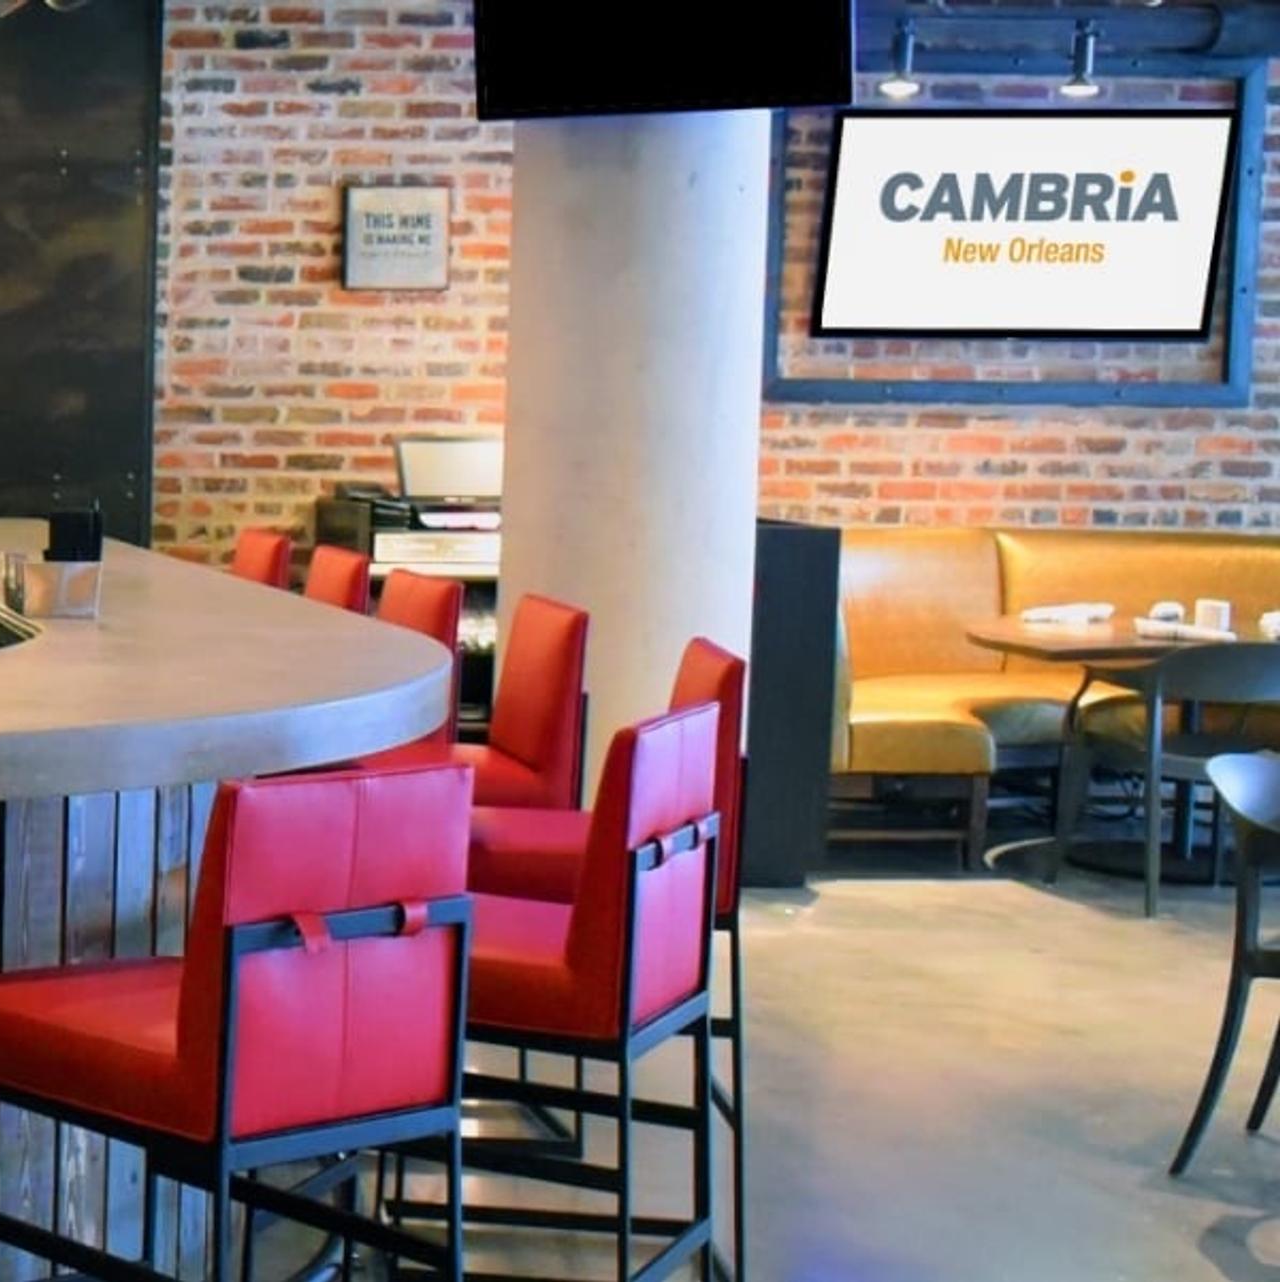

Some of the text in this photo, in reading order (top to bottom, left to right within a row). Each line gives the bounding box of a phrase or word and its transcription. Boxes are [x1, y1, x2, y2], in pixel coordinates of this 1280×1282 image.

[363, 212, 394, 229] THIS
[943, 237, 1106, 264] New Orleans
